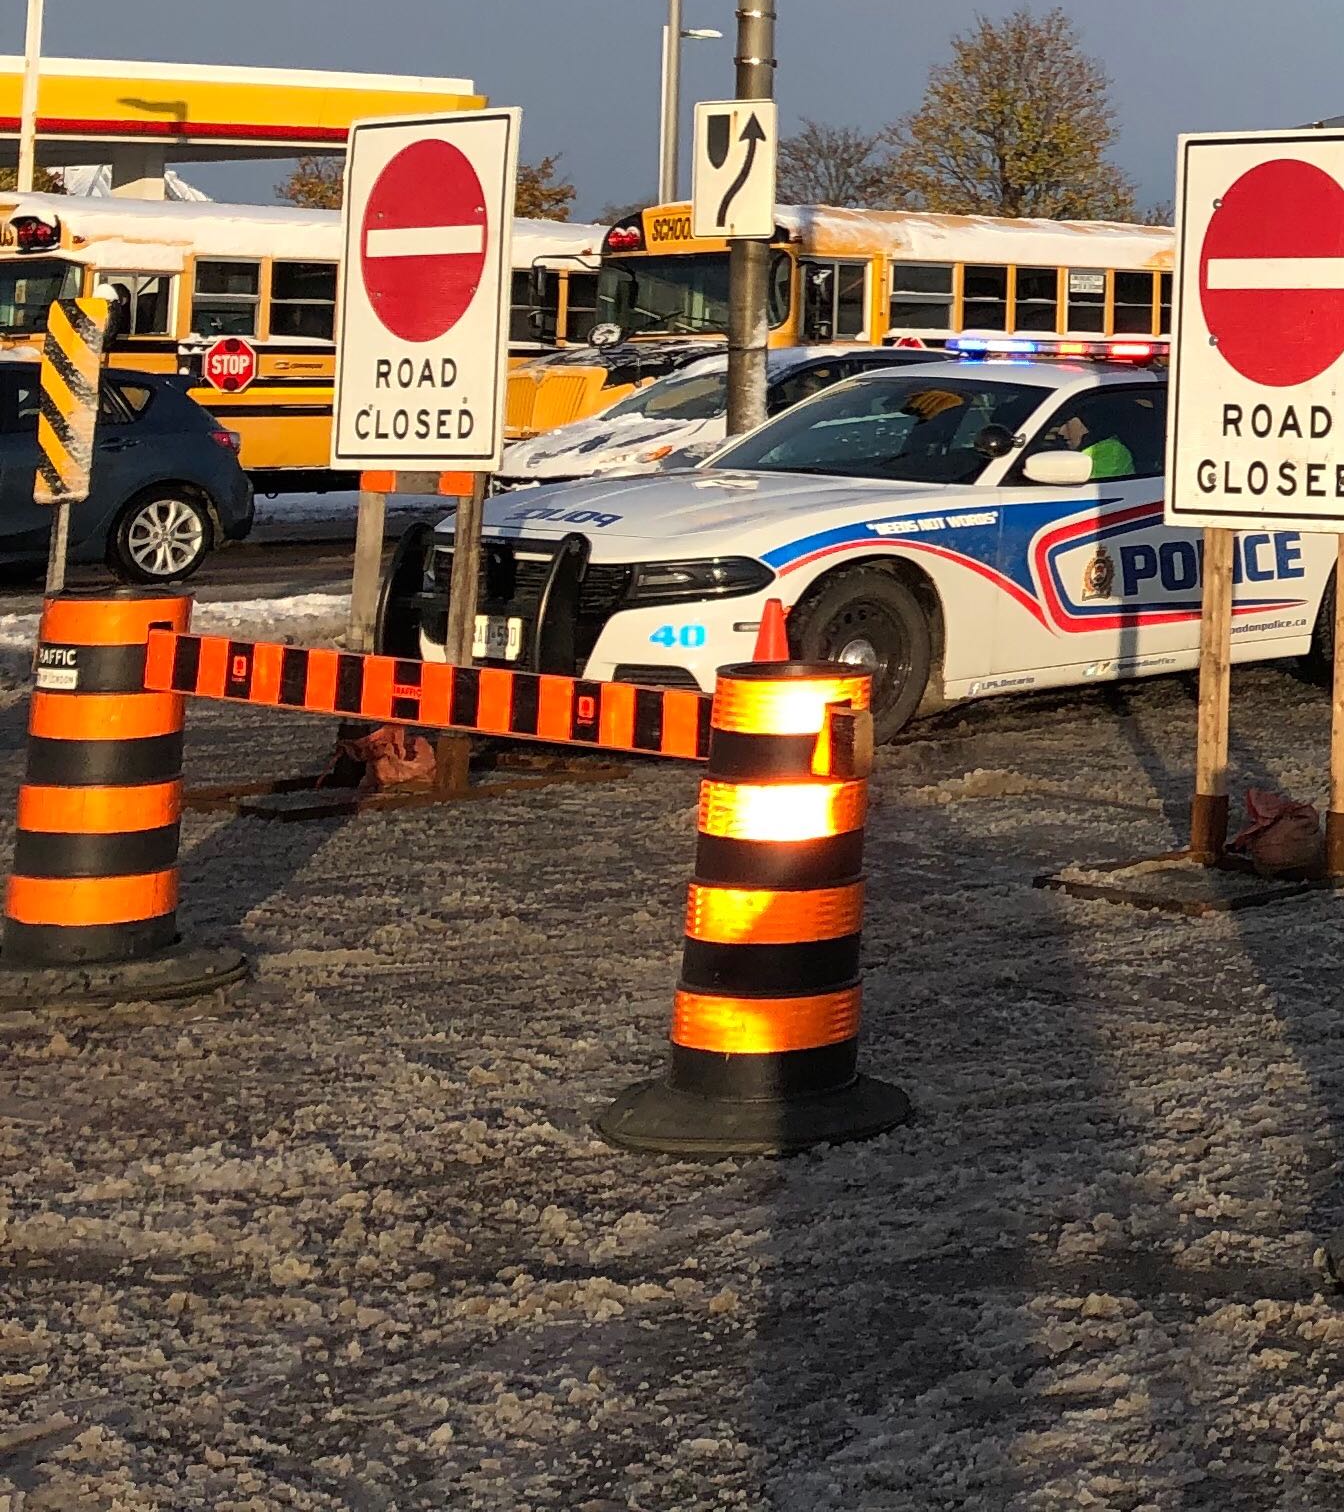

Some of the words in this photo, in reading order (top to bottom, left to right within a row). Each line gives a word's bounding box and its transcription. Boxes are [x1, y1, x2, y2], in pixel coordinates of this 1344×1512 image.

[211, 353, 250, 376] STOP
[375, 357, 458, 389] ROAD
[354, 408, 475, 440] CLOSED
[1222, 403, 1333, 439] ROAD
[649, 624, 706, 648] 40
